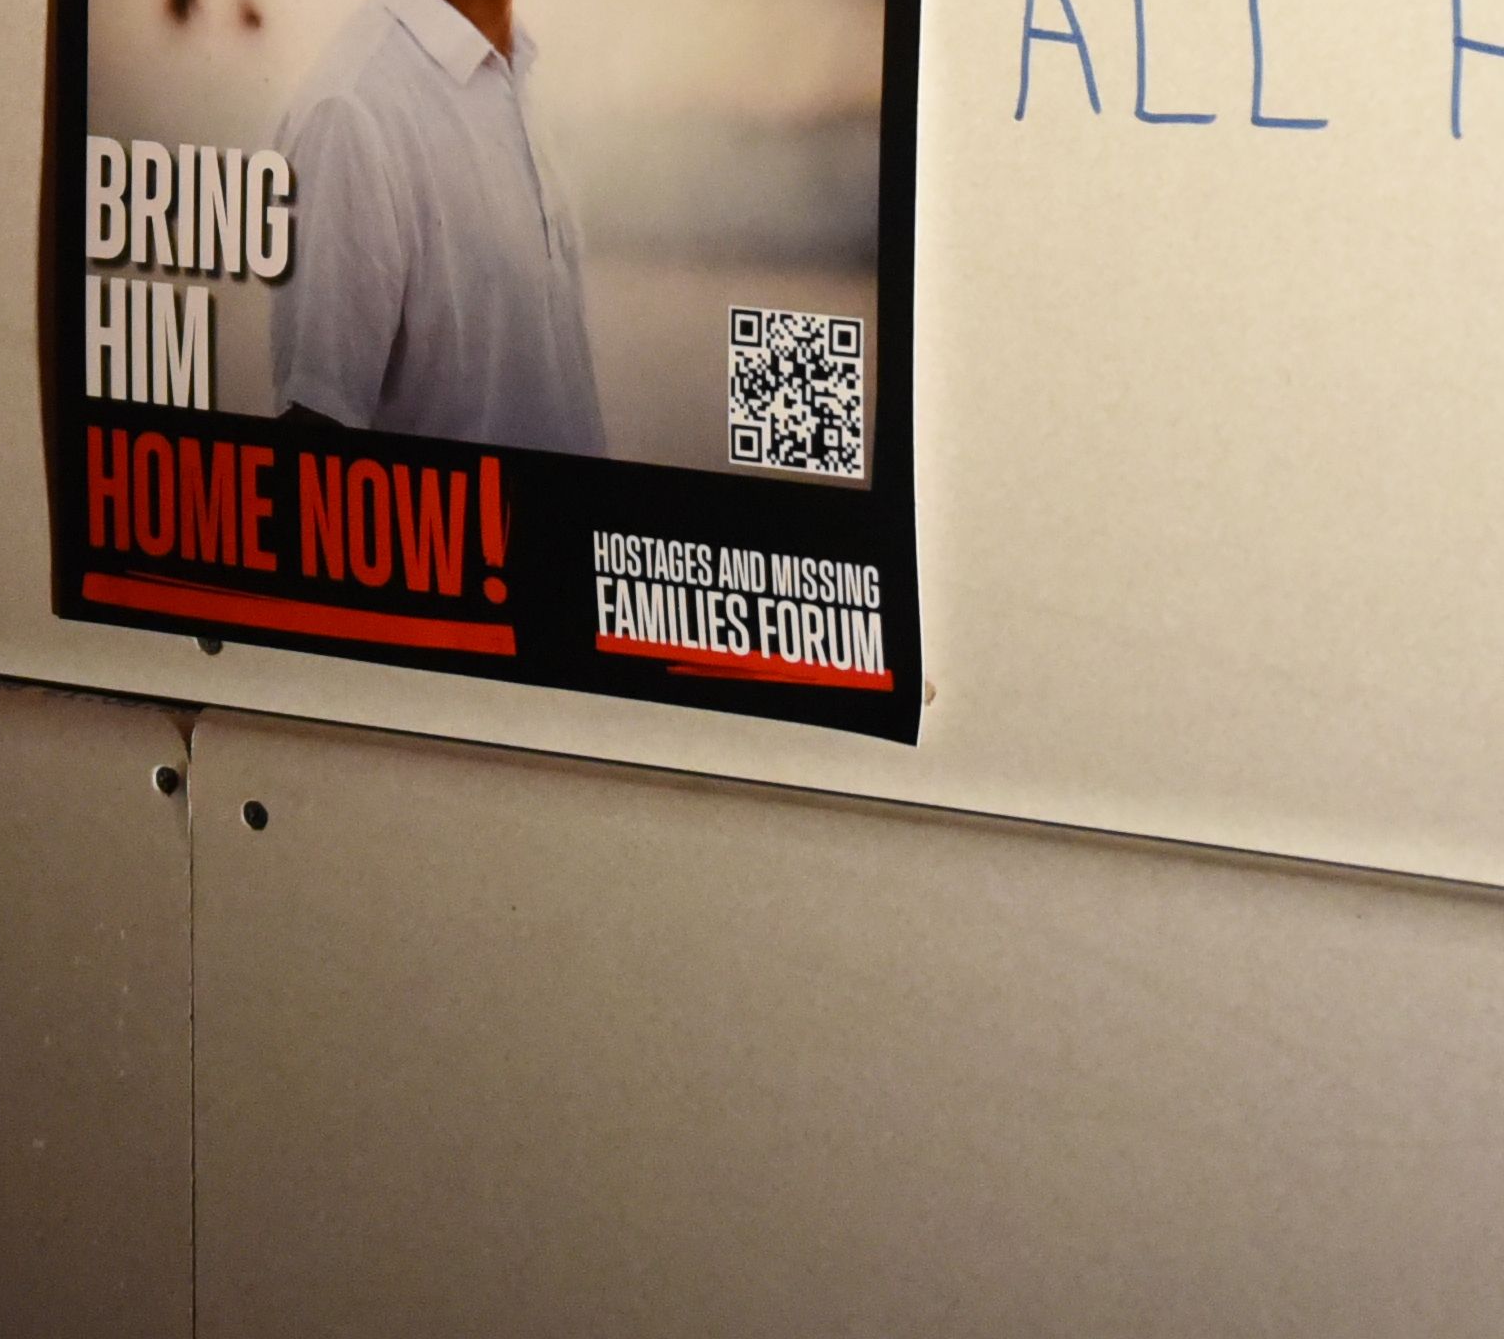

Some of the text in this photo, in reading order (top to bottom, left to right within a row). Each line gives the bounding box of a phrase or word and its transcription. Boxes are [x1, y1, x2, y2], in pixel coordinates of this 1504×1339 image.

[86, 134, 291, 280] BRING
[84, 275, 211, 412] HIM
[86, 424, 512, 607] HOME NOW!
[593, 529, 881, 610] HOSTAGES AND MISSING
[595, 574, 886, 676] FAMILIES FORUM
